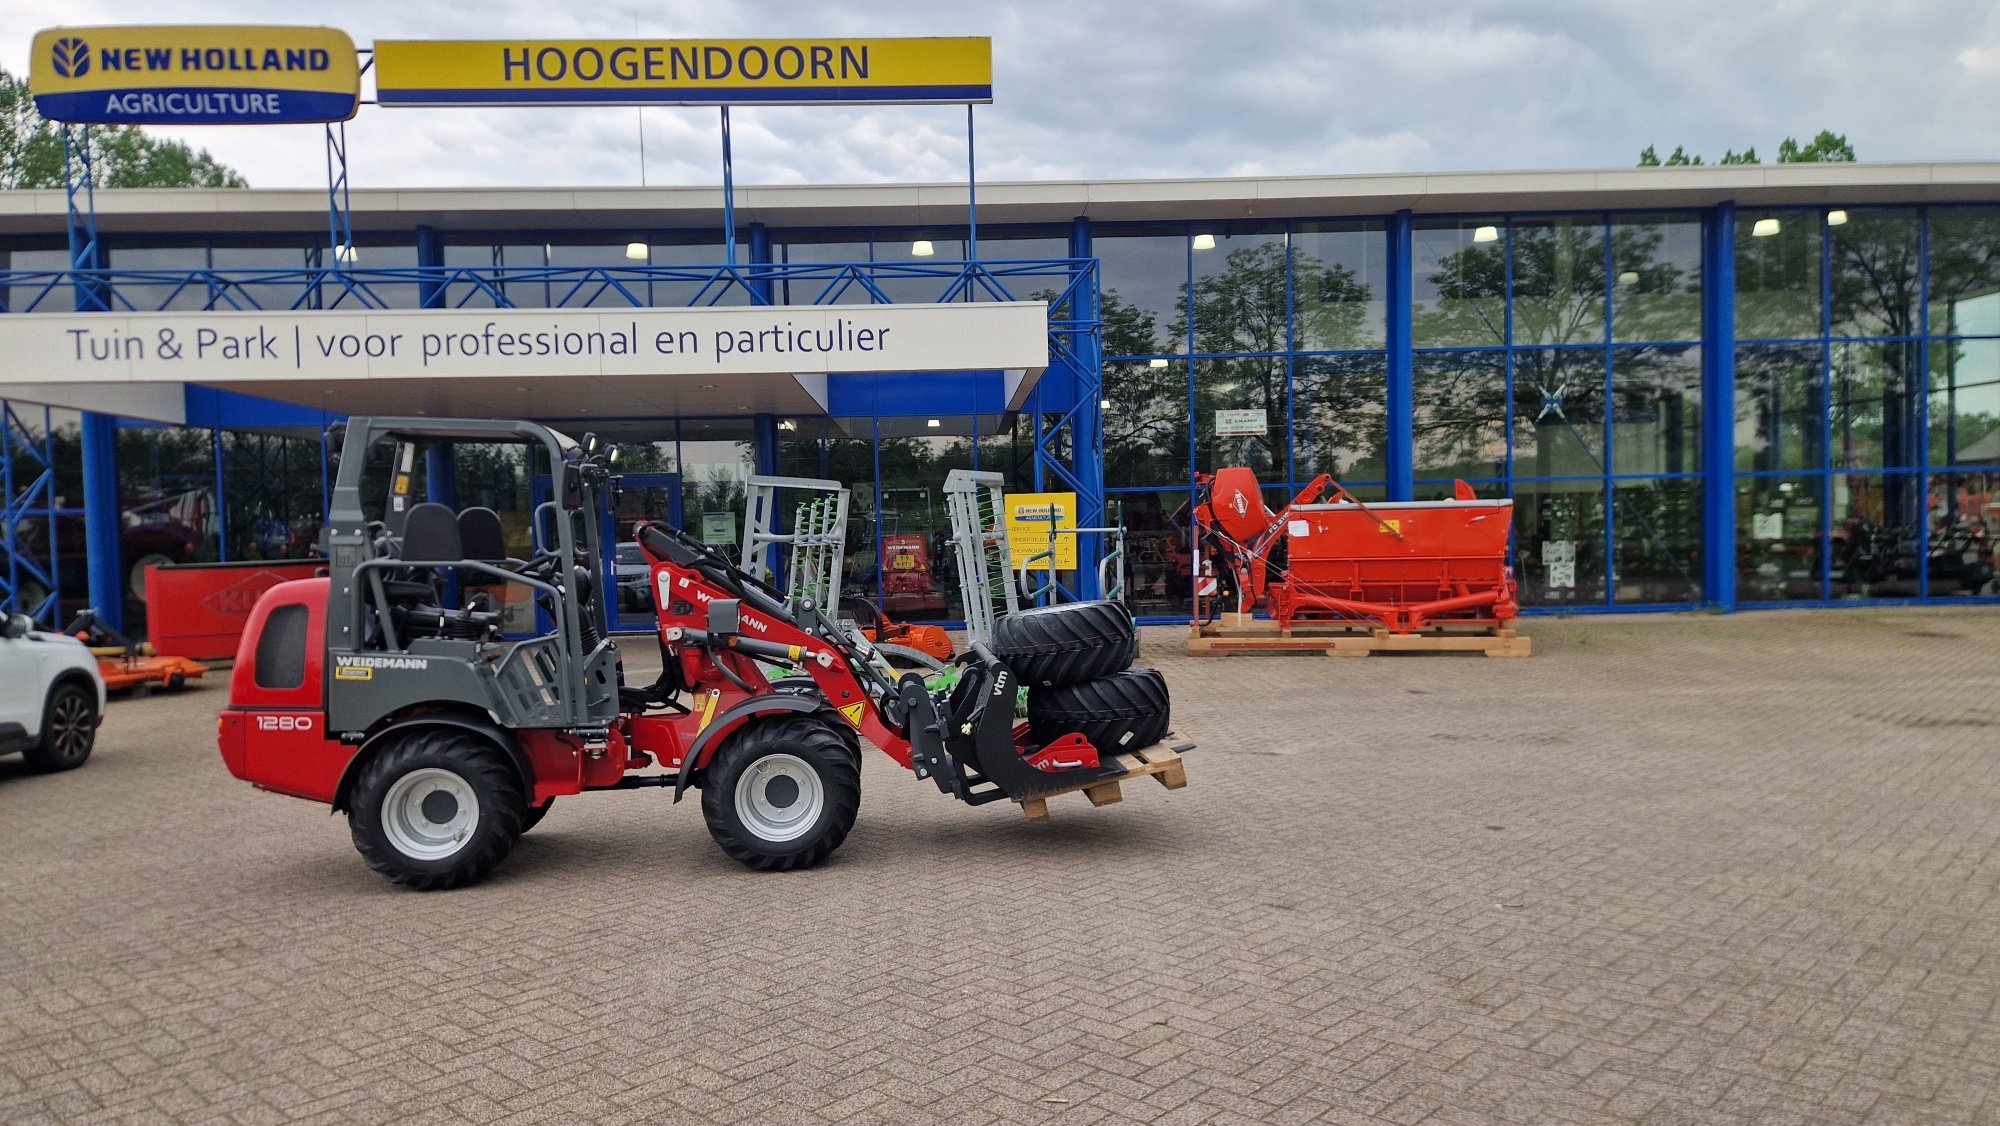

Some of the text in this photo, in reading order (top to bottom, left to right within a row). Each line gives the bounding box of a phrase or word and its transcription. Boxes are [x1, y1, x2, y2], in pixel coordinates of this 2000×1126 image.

[100, 47, 331, 72] NEW HOLLAND
[502, 44, 869, 82] HOOGENDOORN
[106, 92, 281, 114] AGRICULTURE
[66, 328, 144, 361] Tuin
[156, 326, 184, 360] &
[197, 325, 278, 359] Park
[316, 334, 403, 358] voor
[422, 321, 637, 367] professional
[655, 331, 698, 355] en
[715, 318, 891, 364] particulier
[1234, 493, 1245, 515] KUHN
[336, 656, 428, 670] WEIDEMANN
[993, 670, 1008, 696] vtm
[256, 715, 313, 731] 1280
